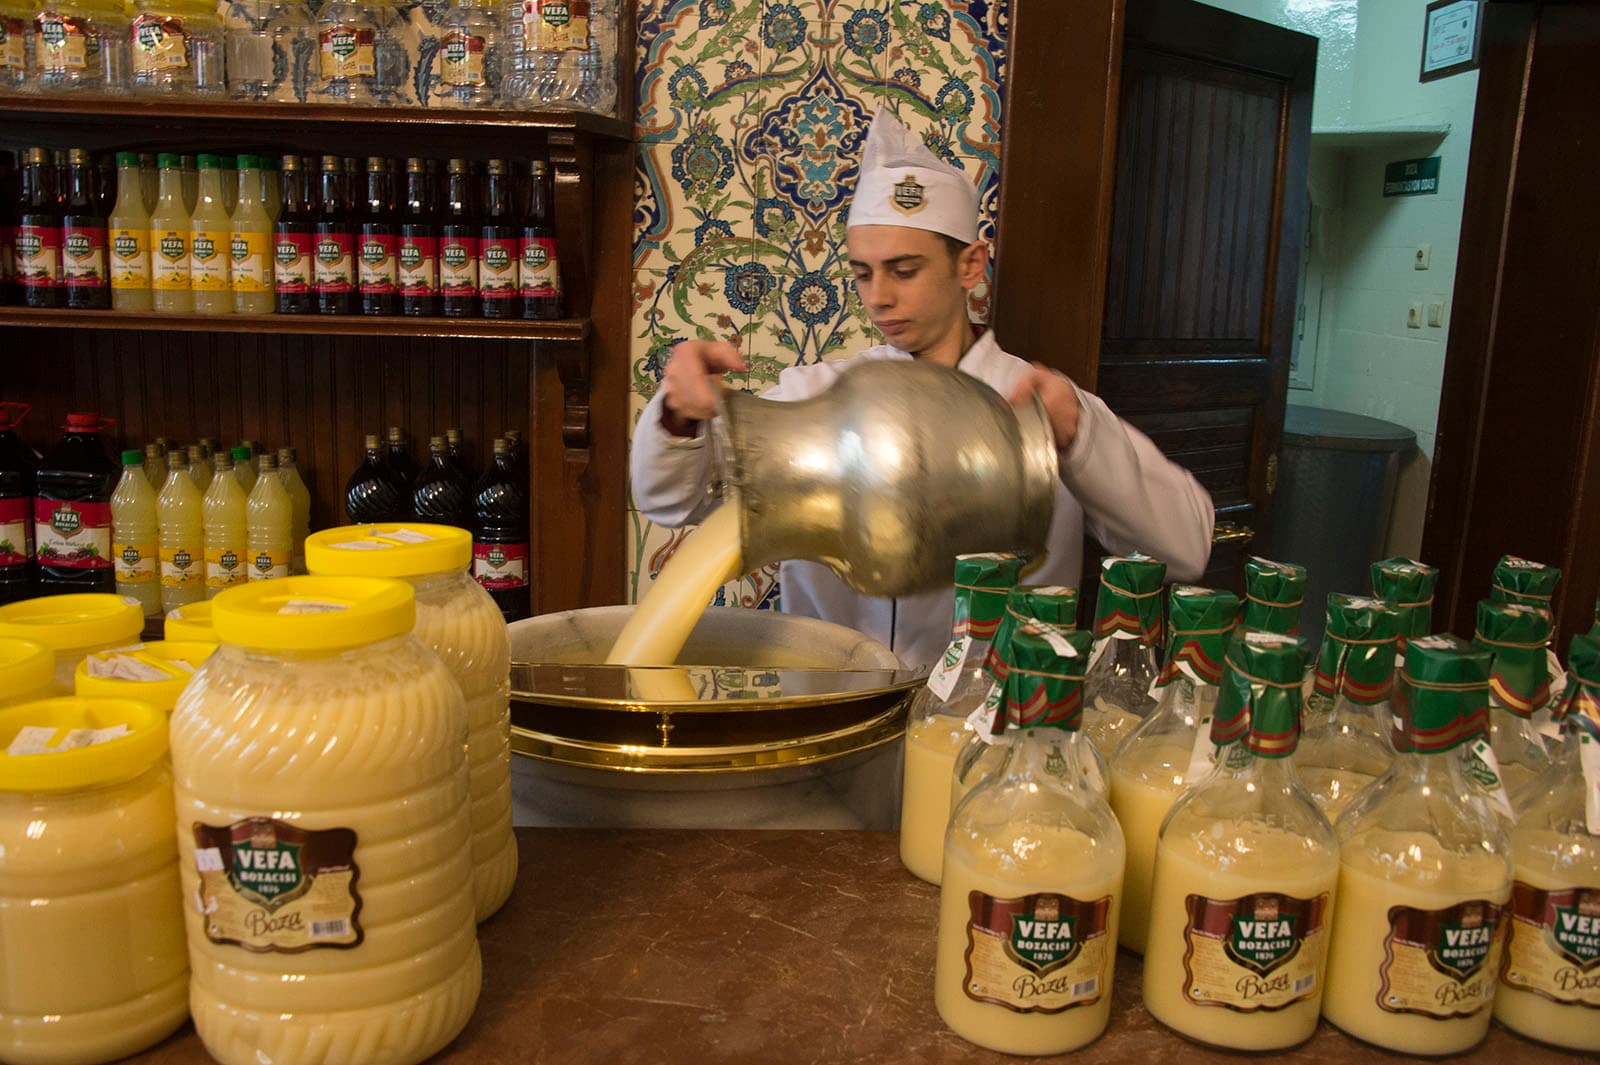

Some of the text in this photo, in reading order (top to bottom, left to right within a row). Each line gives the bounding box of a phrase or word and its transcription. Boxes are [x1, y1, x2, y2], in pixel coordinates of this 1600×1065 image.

[544, 6, 568, 15] VEFA
[332, 36, 354, 45] VEFA
[67, 238, 89, 247] VEFA
[115, 239, 136, 247] VEFA
[162, 240, 183, 248] VEFA
[193, 241, 213, 249] VEFA
[318, 245, 338, 253] VEFA
[363, 246, 383, 254] VEFA
[444, 249, 465, 257] VEFA
[487, 250, 507, 258] VEFA
[525, 249, 546, 257] VEFA
[54, 512, 78, 522] VEFA
[237, 849, 297, 870] VEFA
[240, 871, 297, 883] BOZACISI
[244, 908, 306, 937] Boza
[1560, 912, 1600, 935] VEF
[1018, 920, 1072, 940] VEFA
[1238, 920, 1292, 939] VEFA
[1445, 927, 1489, 947] VEFA
[1017, 939, 1070, 951] BOZACISI
[1238, 939, 1291, 951] BOZACISI
[1012, 973, 1070, 1000] Boza
[1235, 972, 1291, 1000] Boza
